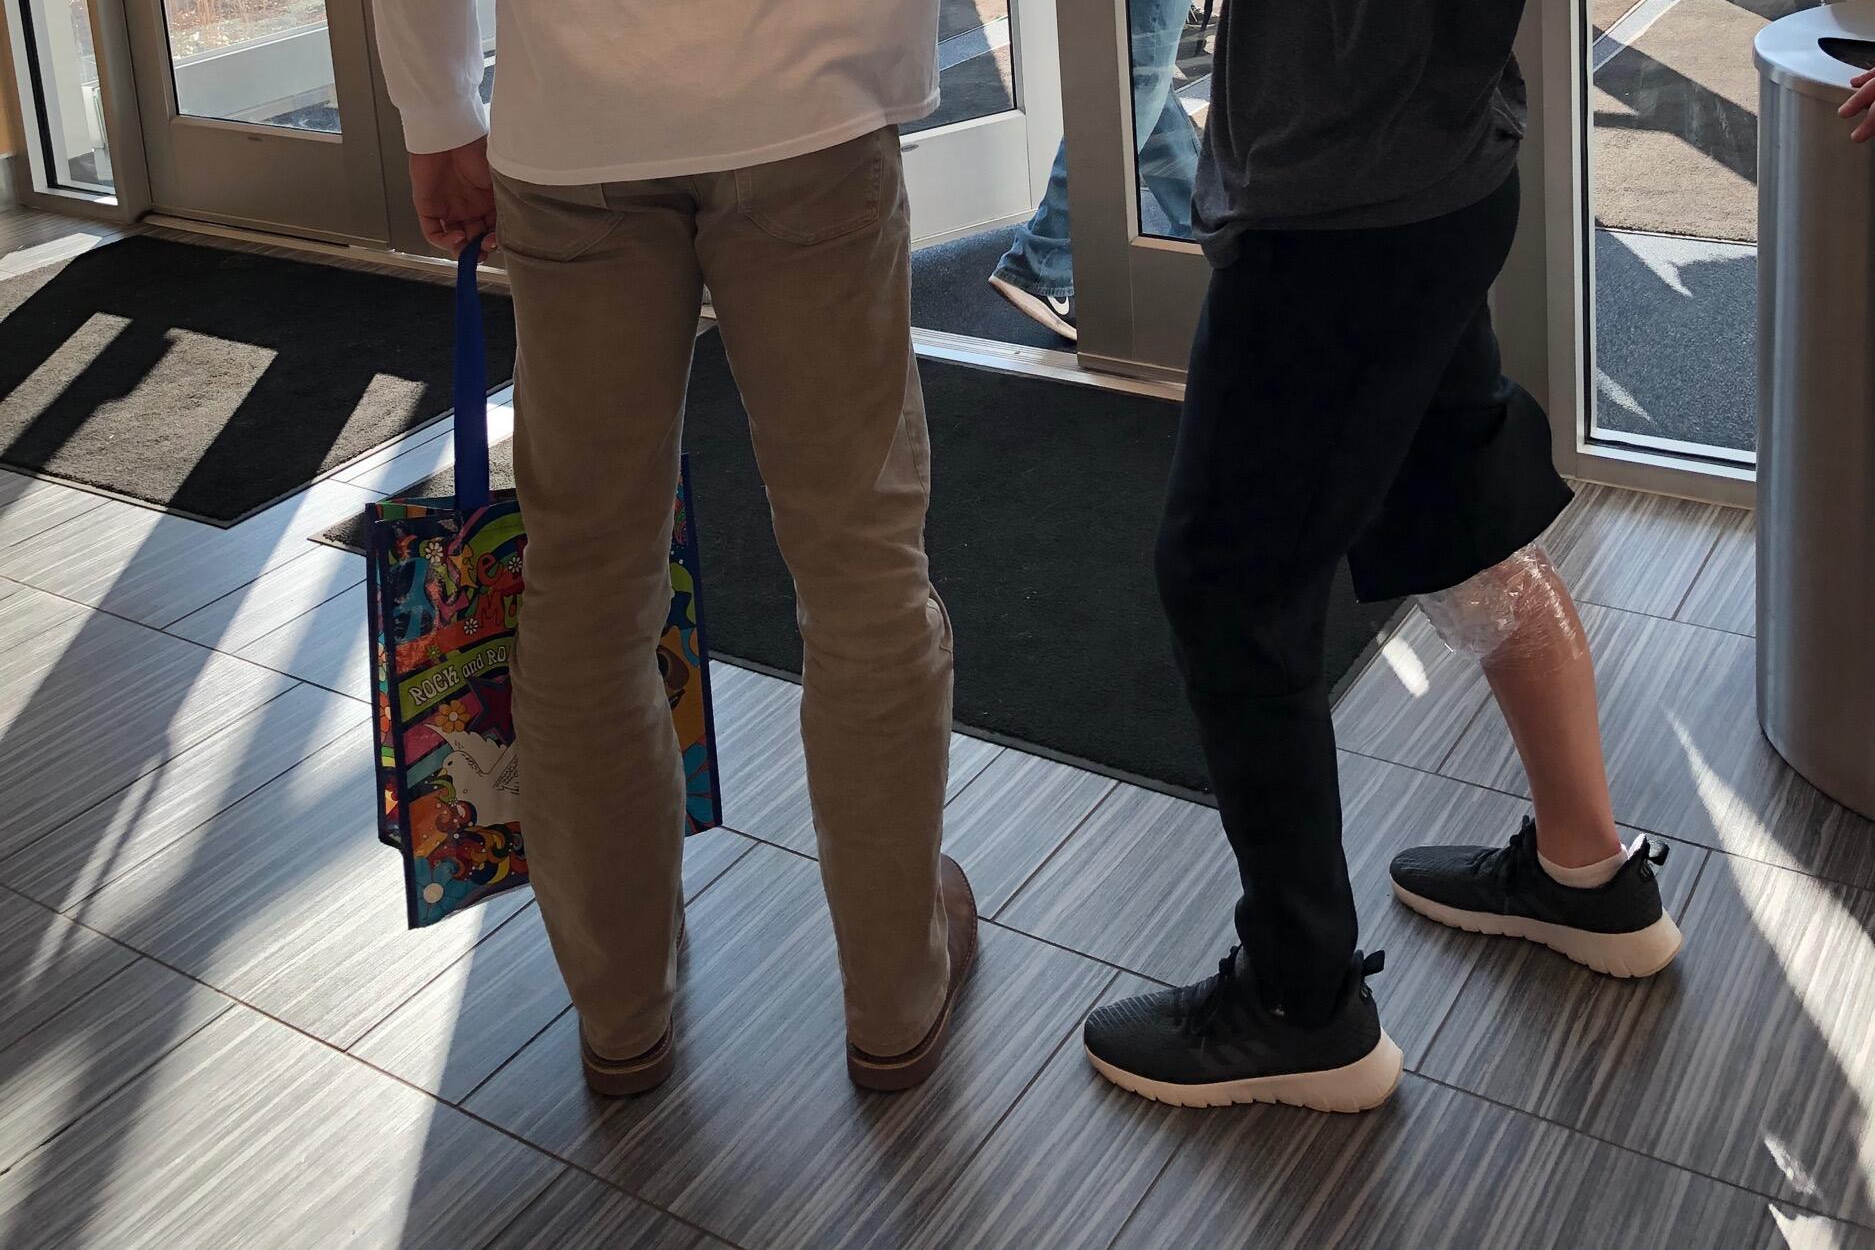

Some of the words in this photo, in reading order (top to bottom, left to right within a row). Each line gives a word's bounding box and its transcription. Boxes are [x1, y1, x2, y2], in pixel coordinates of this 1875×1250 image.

[409, 665, 460, 706] ROCK
[462, 653, 484, 678] and
[486, 646, 510, 666] RO
